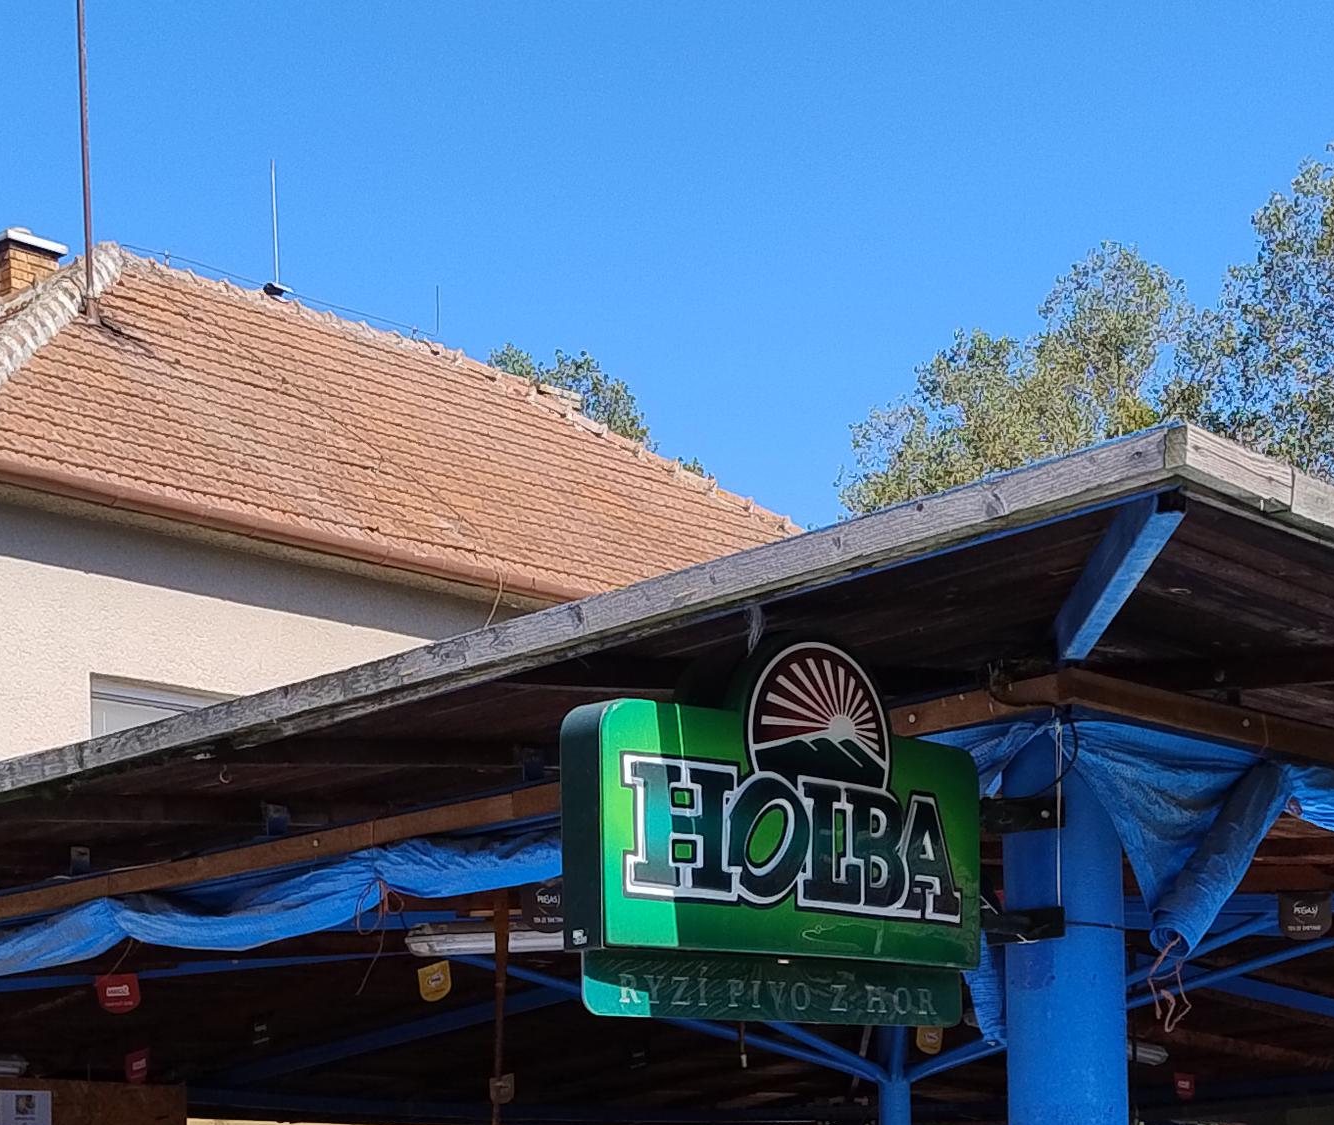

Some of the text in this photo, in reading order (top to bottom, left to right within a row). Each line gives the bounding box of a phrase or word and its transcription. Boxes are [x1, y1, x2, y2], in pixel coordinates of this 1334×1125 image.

[619, 751, 962, 925] HOLBA
[618, 967, 939, 1016] RYZÍ PIVO Z HOR
